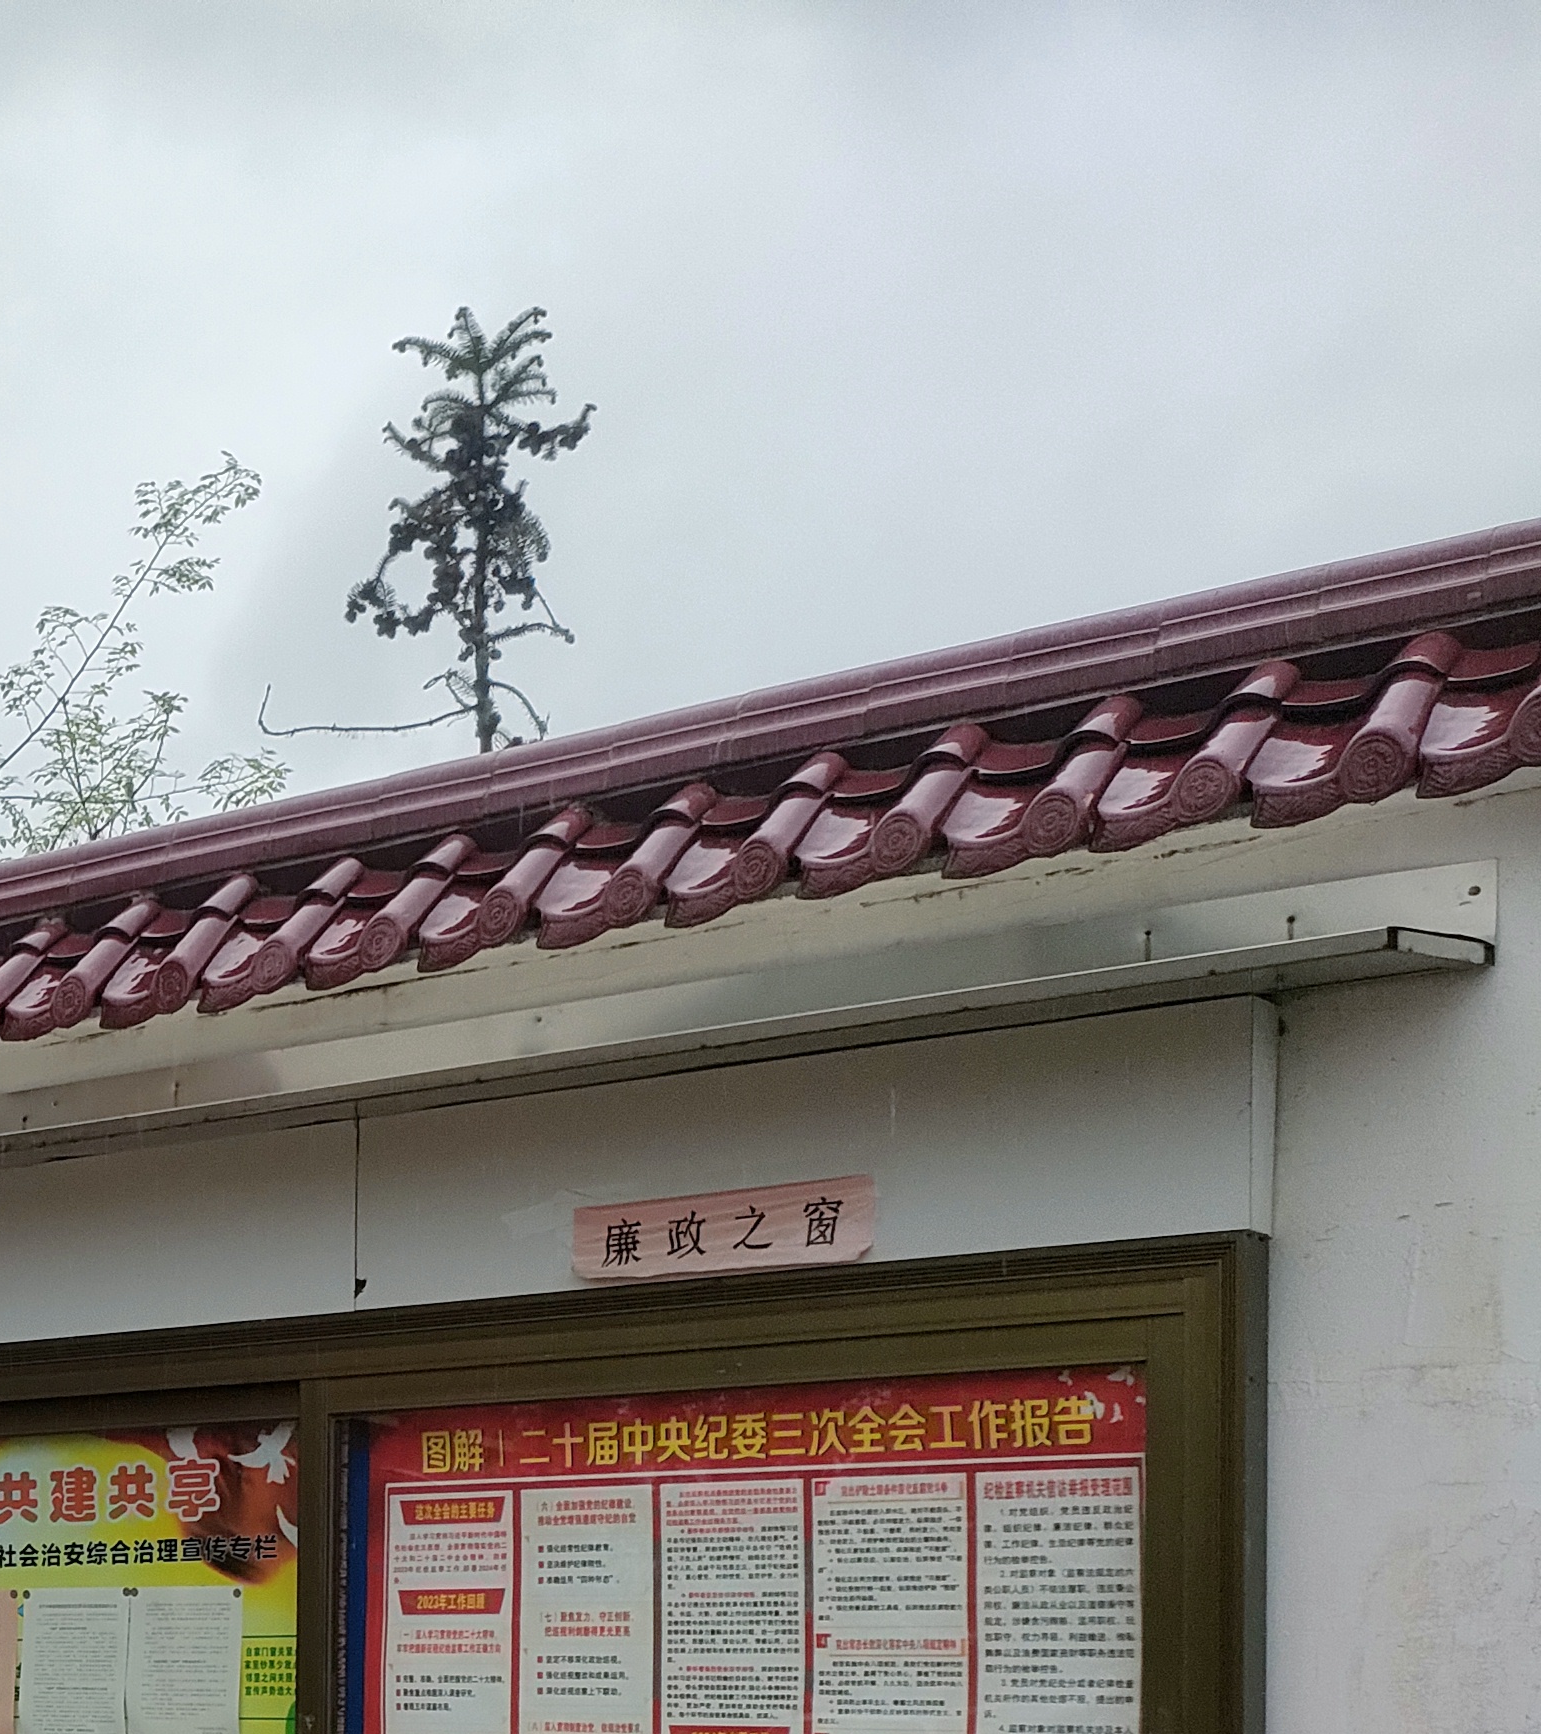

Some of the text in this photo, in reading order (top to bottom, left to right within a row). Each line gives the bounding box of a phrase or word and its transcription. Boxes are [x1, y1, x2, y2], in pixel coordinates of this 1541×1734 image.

[601, 1197, 844, 1268] 廉政之窗
[983, 1477, 1134, 1500] 纪检监察机关信访举报受理范围
[415, 1502, 496, 1521] 这次全会的主要任务
[416, 1593, 486, 1610] 2023年工作回顾
